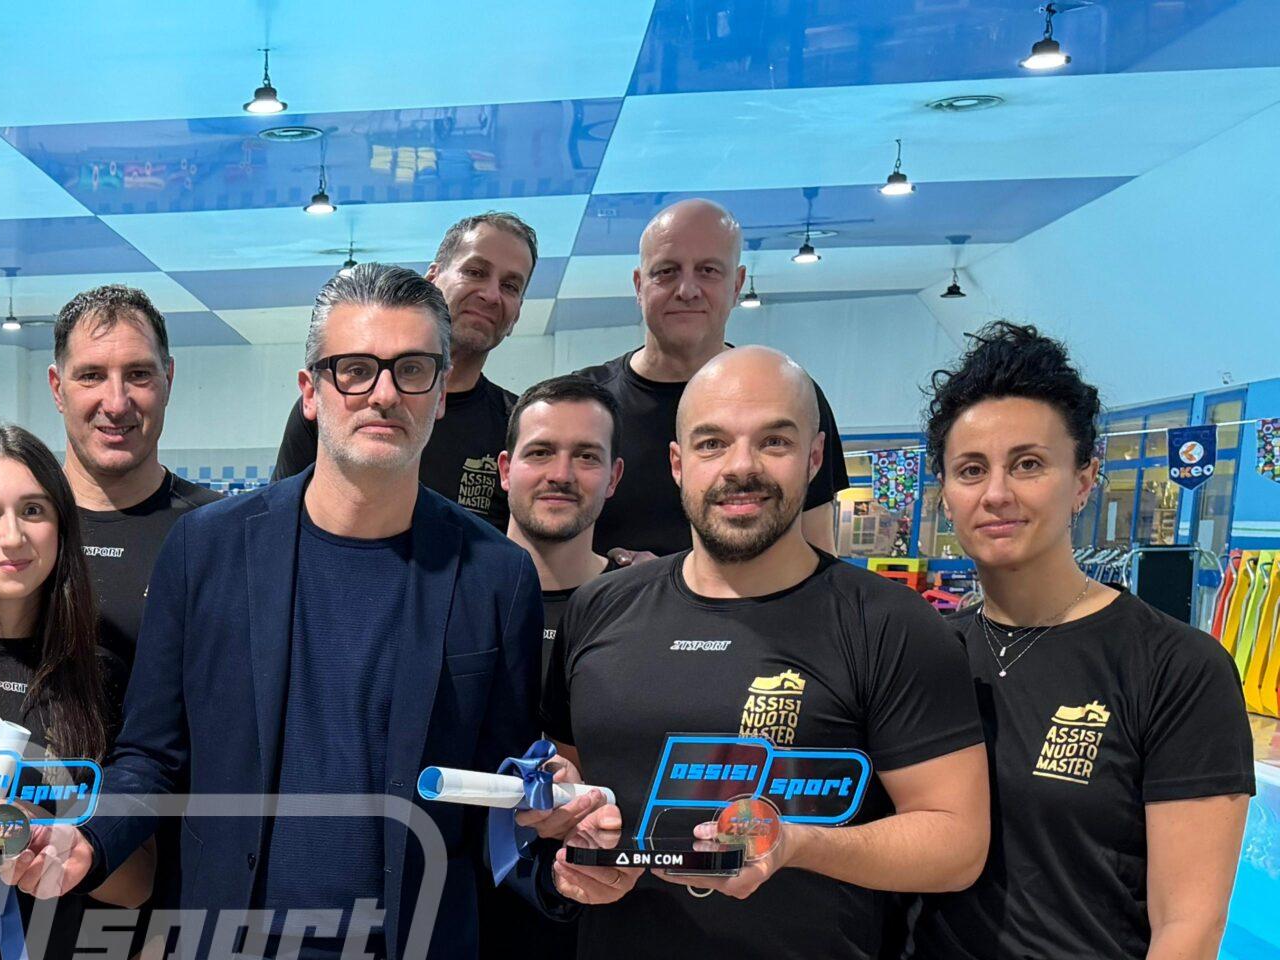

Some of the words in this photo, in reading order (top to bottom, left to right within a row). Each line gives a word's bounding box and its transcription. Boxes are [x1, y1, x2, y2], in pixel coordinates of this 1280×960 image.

[460, 472, 496, 487] ASSISI
[459, 484, 494, 498] NUOTO
[458, 494, 491, 510] MASTER
[670, 640, 732, 651] 2TSPORT
[743, 695, 802, 715] ASSISI
[741, 710, 799, 729] NUOTO
[1045, 725, 1104, 747] ASSISI
[1040, 741, 1098, 761] NUOTO
[670, 763, 758, 781] assisi
[1035, 755, 1094, 778] MASTER
[20, 782, 89, 805] sport
[768, 777, 853, 800] sport
[633, 854, 651, 864] BN
[654, 854, 683, 866] COM
